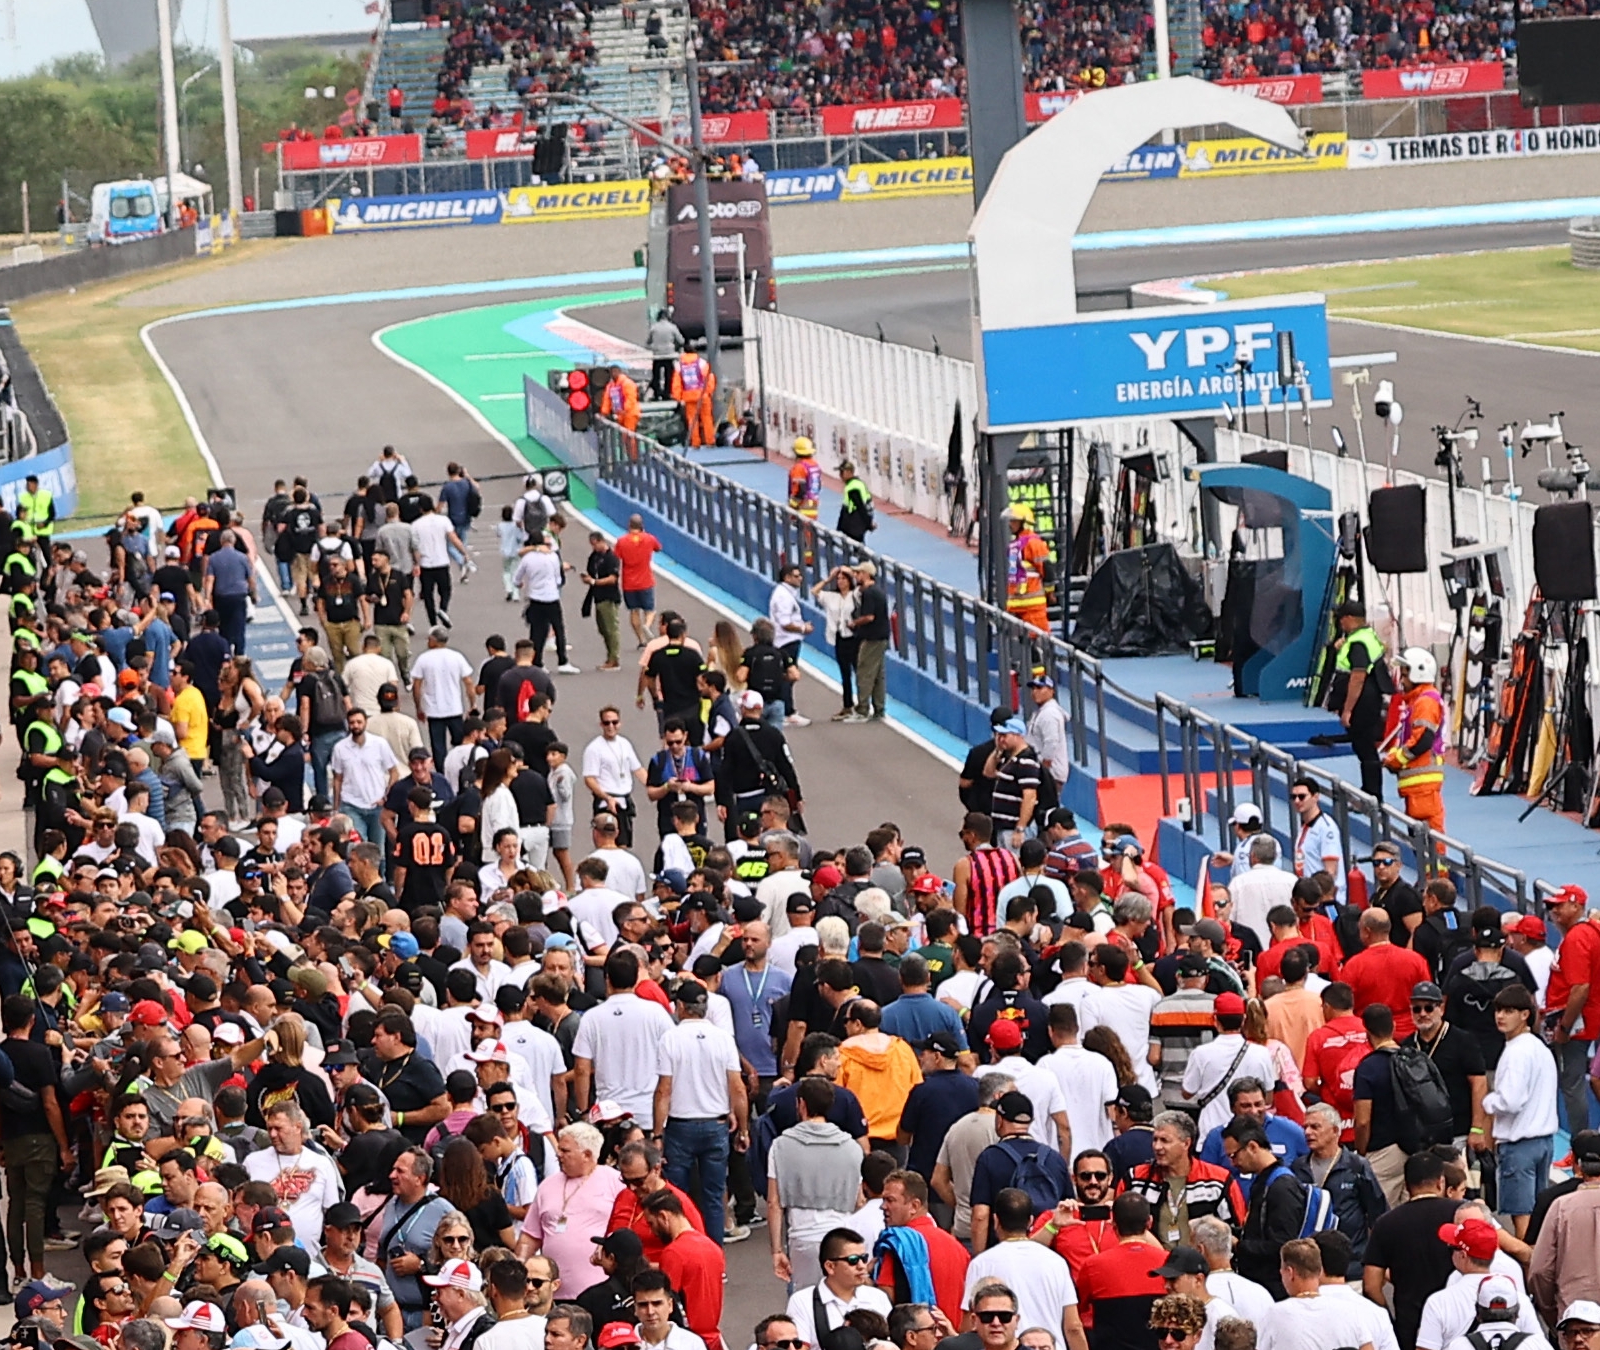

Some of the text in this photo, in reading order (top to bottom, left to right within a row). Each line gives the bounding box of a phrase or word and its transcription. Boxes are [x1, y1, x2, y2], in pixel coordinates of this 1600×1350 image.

[1388, 135, 1463, 160] TERMAS
[1468, 132, 1492, 155] DE
[362, 195, 499, 222] MICHELIN
[1128, 321, 1274, 371] YPF
[1116, 374, 1194, 403] ENERGÍA
[547, 476, 565, 488] GO
[412, 832, 445, 866] 01
[736, 860, 768, 878] 46
